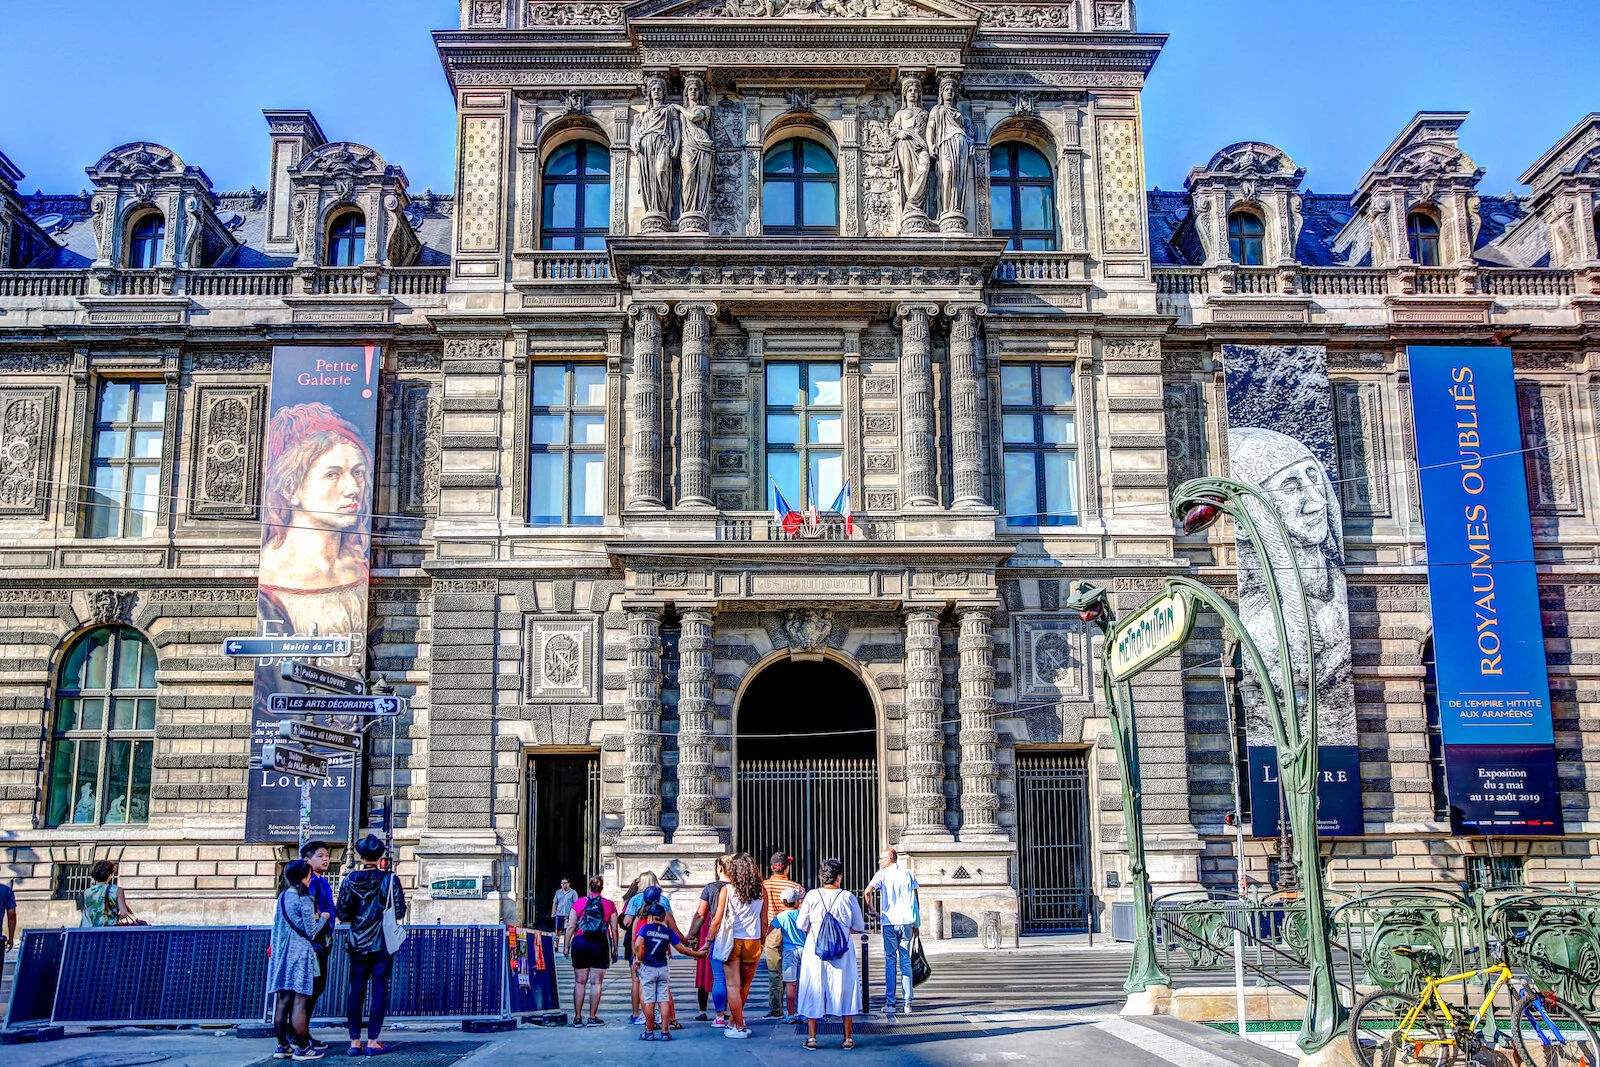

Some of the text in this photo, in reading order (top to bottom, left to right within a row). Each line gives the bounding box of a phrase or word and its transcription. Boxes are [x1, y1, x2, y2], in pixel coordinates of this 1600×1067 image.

[315, 359, 359, 374] Petite
[297, 372, 352, 389] Galerie
[1447, 366, 1504, 676] ROYAUMES OUBLIÉS
[282, 643, 310, 651] Mairie
[312, 643, 323, 651] du
[301, 668, 347, 689] Palais du LOUVRE
[289, 699, 374, 709] LES ARTS DÉCORATIFS
[1449, 699, 1542, 708] DE L'EMPIRE HITTITE
[1481, 709, 1534, 718] ARAMÉENS
[300, 727, 345, 744] Musée du LOUVRE
[260, 771, 347, 788] LOUVRE
[1478, 768, 1527, 780] Exposition
[1483, 780, 1496, 789] du
[1506, 780, 1524, 789] mai
[1496, 792, 1517, 801] août
[1518, 794, 1540, 803] 2019
[650, 938, 662, 955] 7
